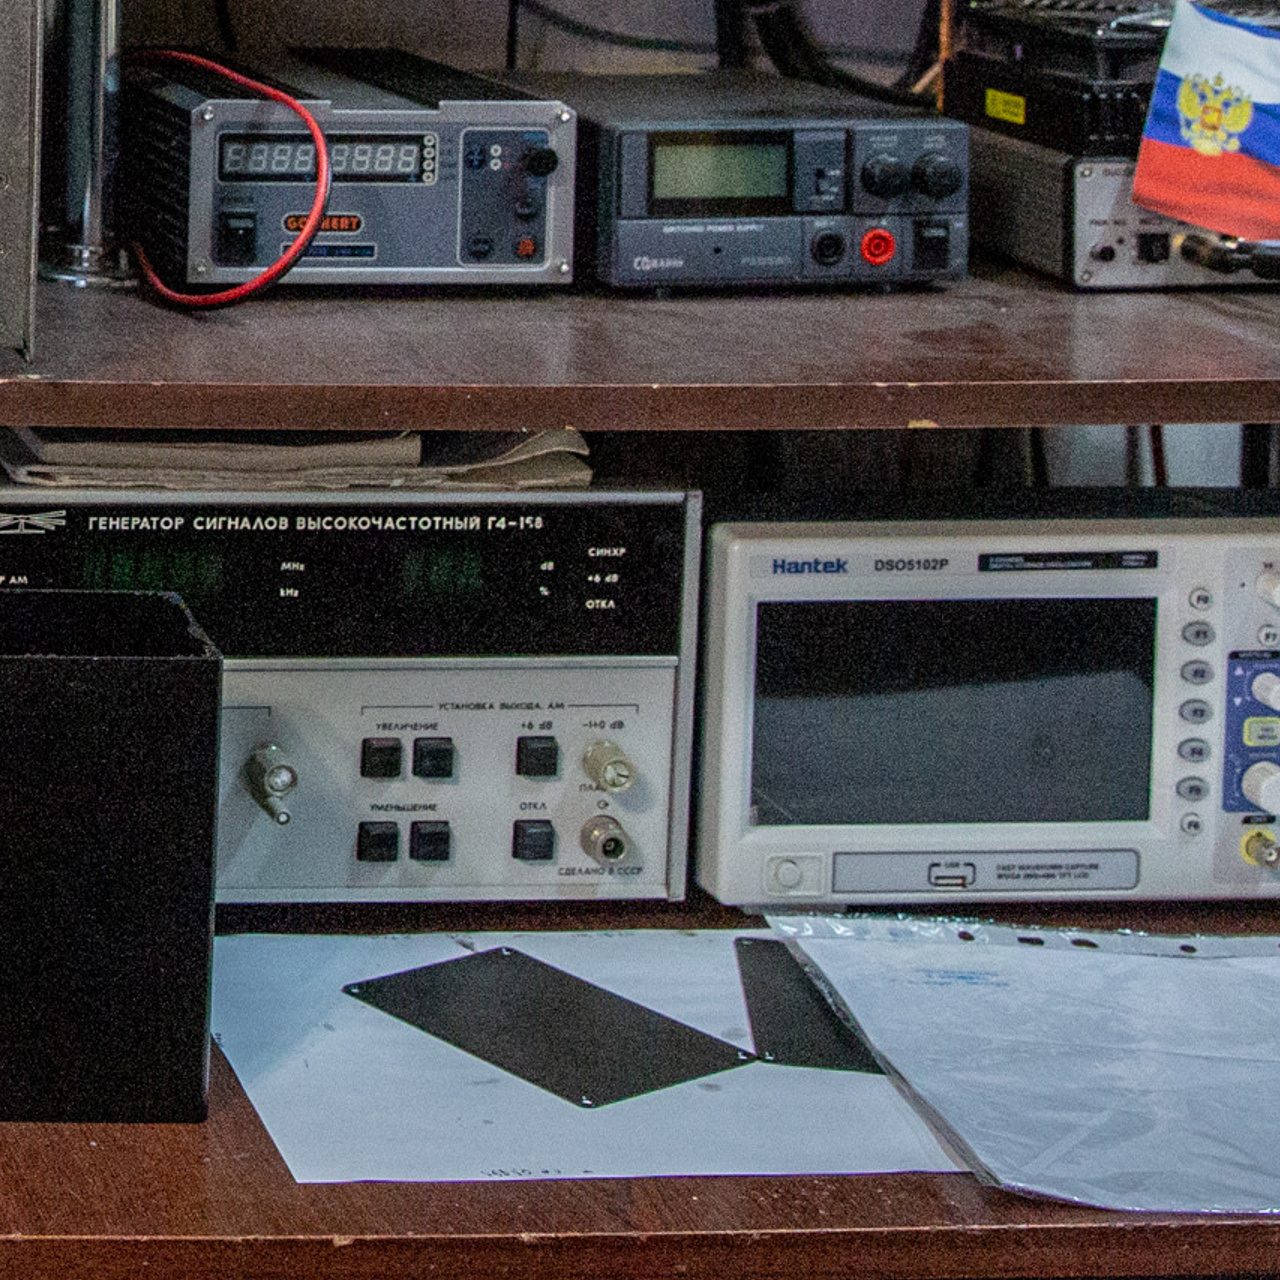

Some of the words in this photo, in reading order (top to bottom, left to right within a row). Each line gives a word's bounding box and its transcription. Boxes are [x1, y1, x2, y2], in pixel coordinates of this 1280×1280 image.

[88, 516, 184, 531] ГЕНЕРАТОР
[193, 516, 288, 531] СИГНАЛОВ
[296, 515, 481, 531] ВЫСОКОЧАСТОТНЫЙ
[588, 547, 626, 557] СИНХР
[772, 558, 848, 575] Hantek
[874, 558, 949, 572] DSO5102P
[9, 575, 28, 585] АМ
[586, 599, 615, 609] ОТКЛ
[439, 702, 494, 711] УСТАНОВКА
[376, 722, 439, 731] УВЕЛИЧЕНИЕ
[370, 803, 437, 812] УМЕНЬШЕНИЕ
[520, 802, 547, 811] ОТКЛ
[558, 867, 605, 876] СДЕЛАНО
[617, 867, 643, 876] СССР
